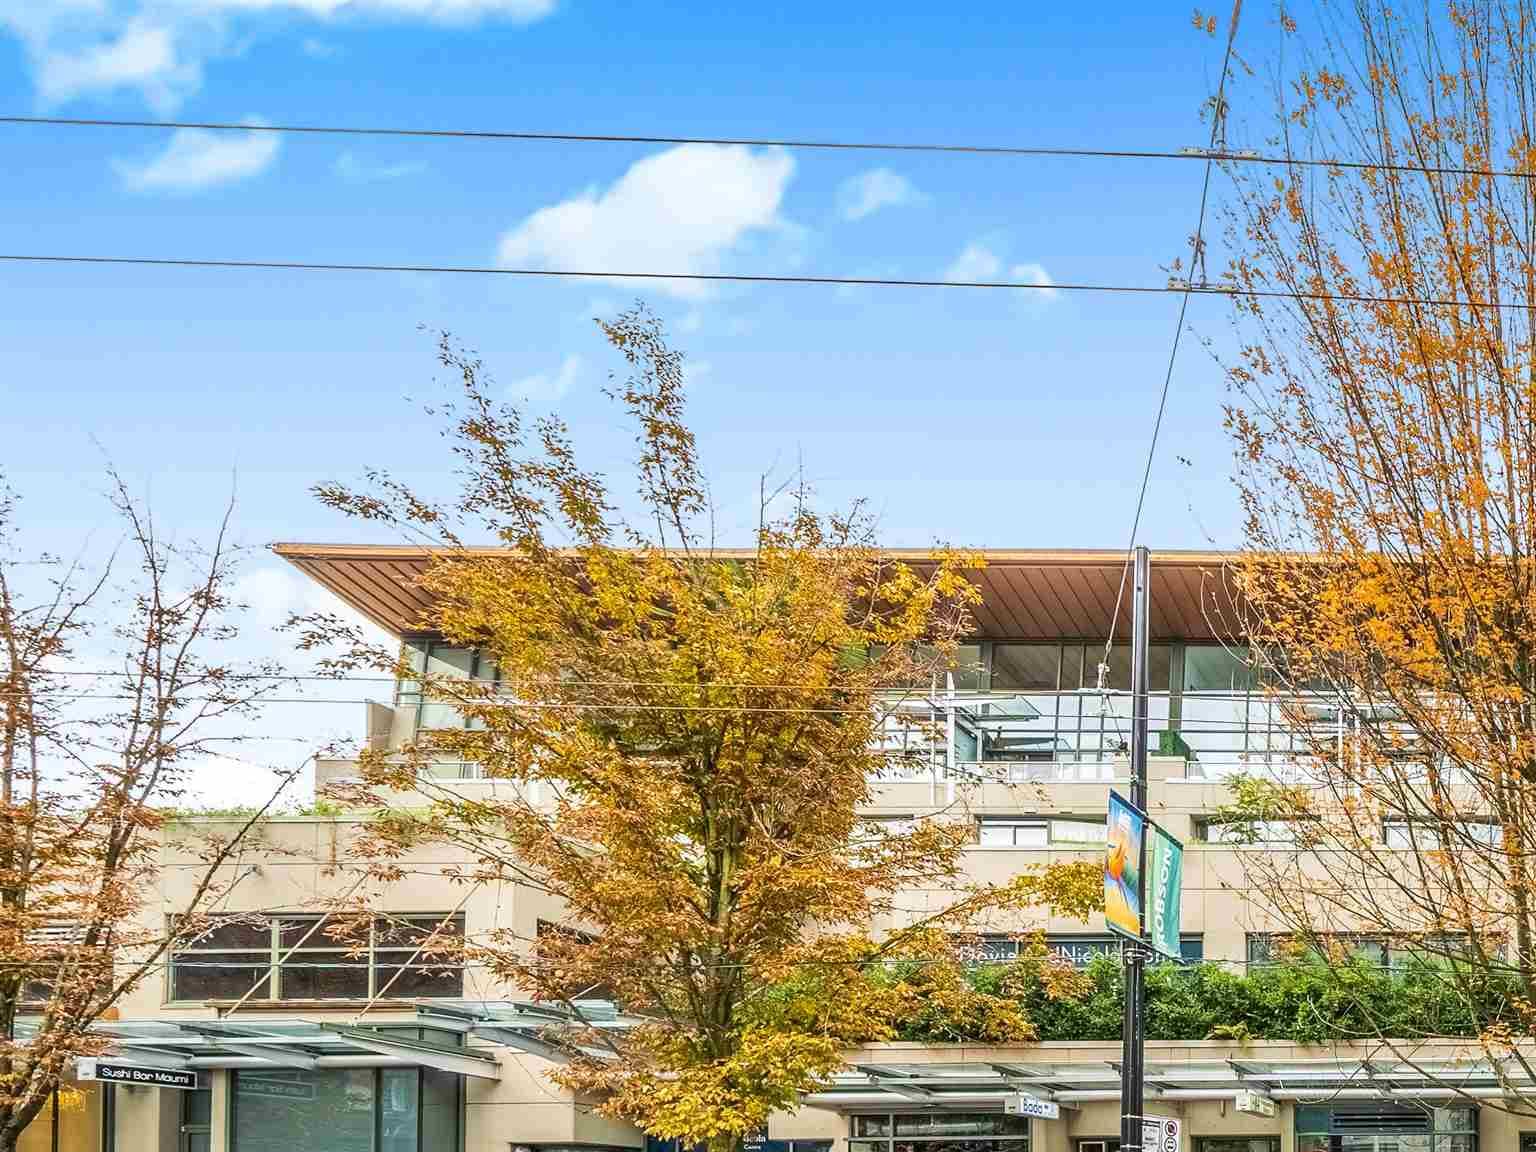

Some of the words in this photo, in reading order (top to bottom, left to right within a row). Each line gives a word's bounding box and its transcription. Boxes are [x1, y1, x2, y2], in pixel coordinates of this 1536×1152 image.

[1154, 847, 1173, 948] ROBSON
[101, 1067, 131, 1079] Sushi
[133, 1070, 154, 1080] Bar
[155, 1073, 189, 1084] Maumi
